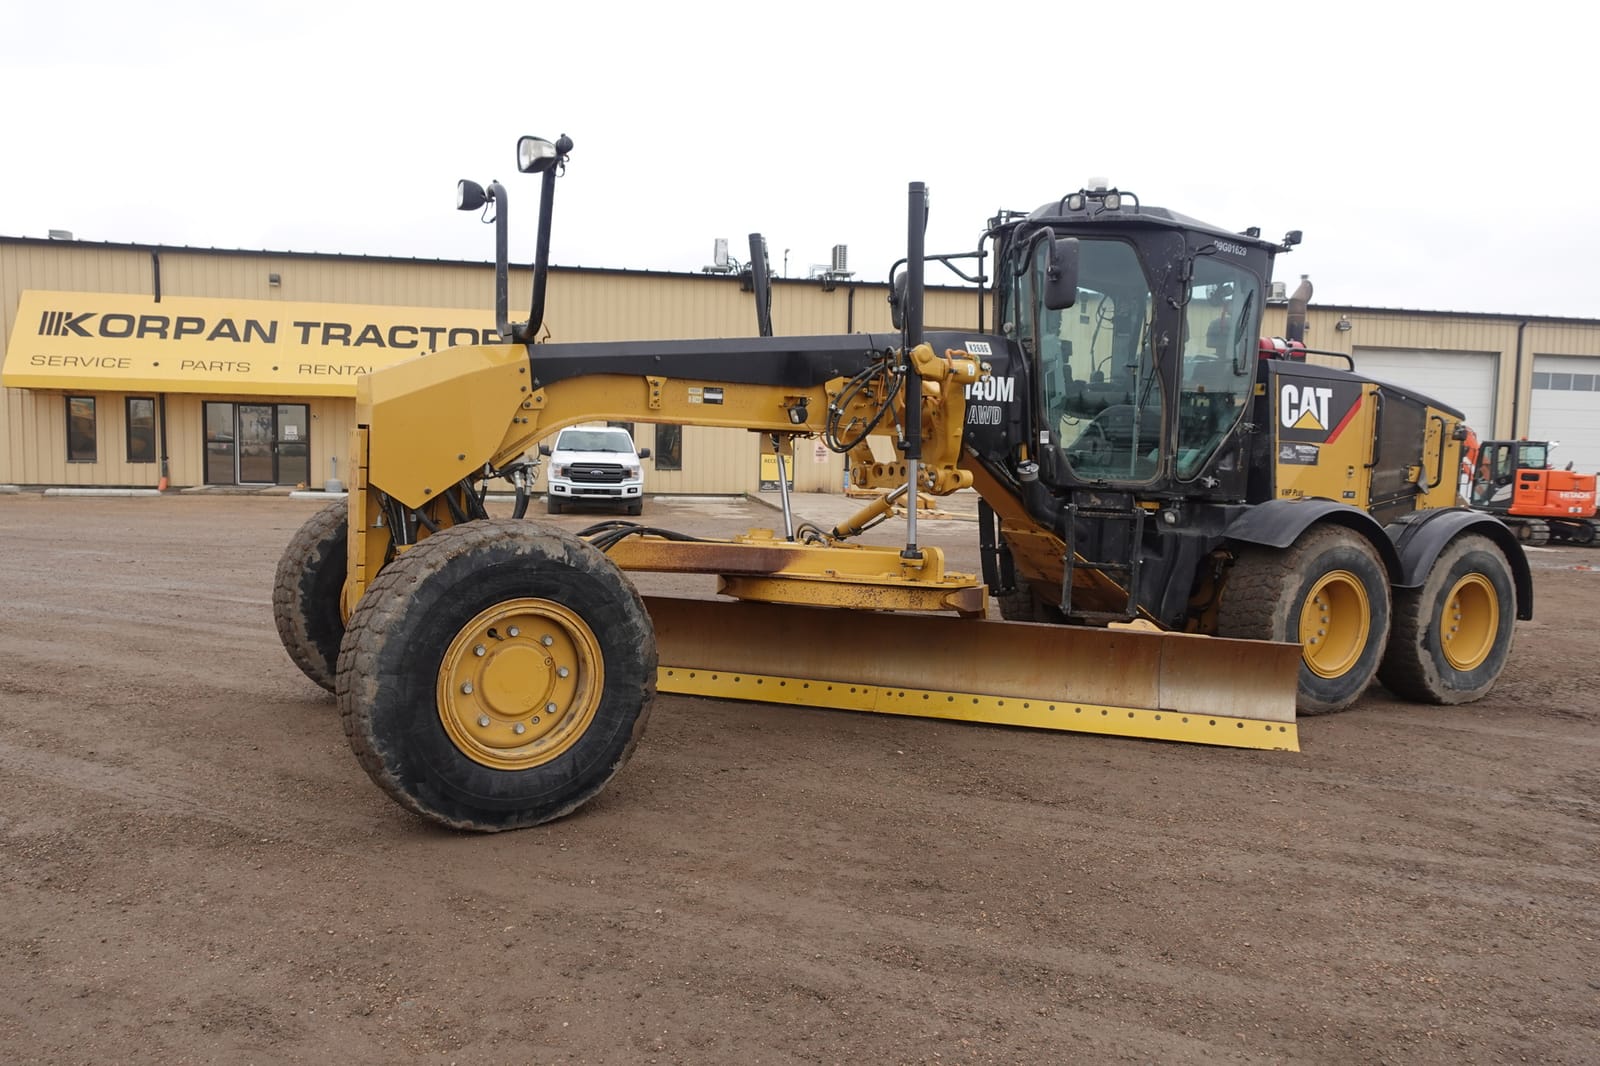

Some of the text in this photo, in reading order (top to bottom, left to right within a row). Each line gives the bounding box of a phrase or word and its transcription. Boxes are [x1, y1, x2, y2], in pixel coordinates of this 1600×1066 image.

[38, 311, 278, 344] KORPAN
[30, 355, 132, 369] SERVICE
[180, 359, 251, 373] PARTS
[965, 375, 1015, 402] 140M
[967, 405, 1002, 425] AWD
[1281, 384, 1333, 431] CAT
